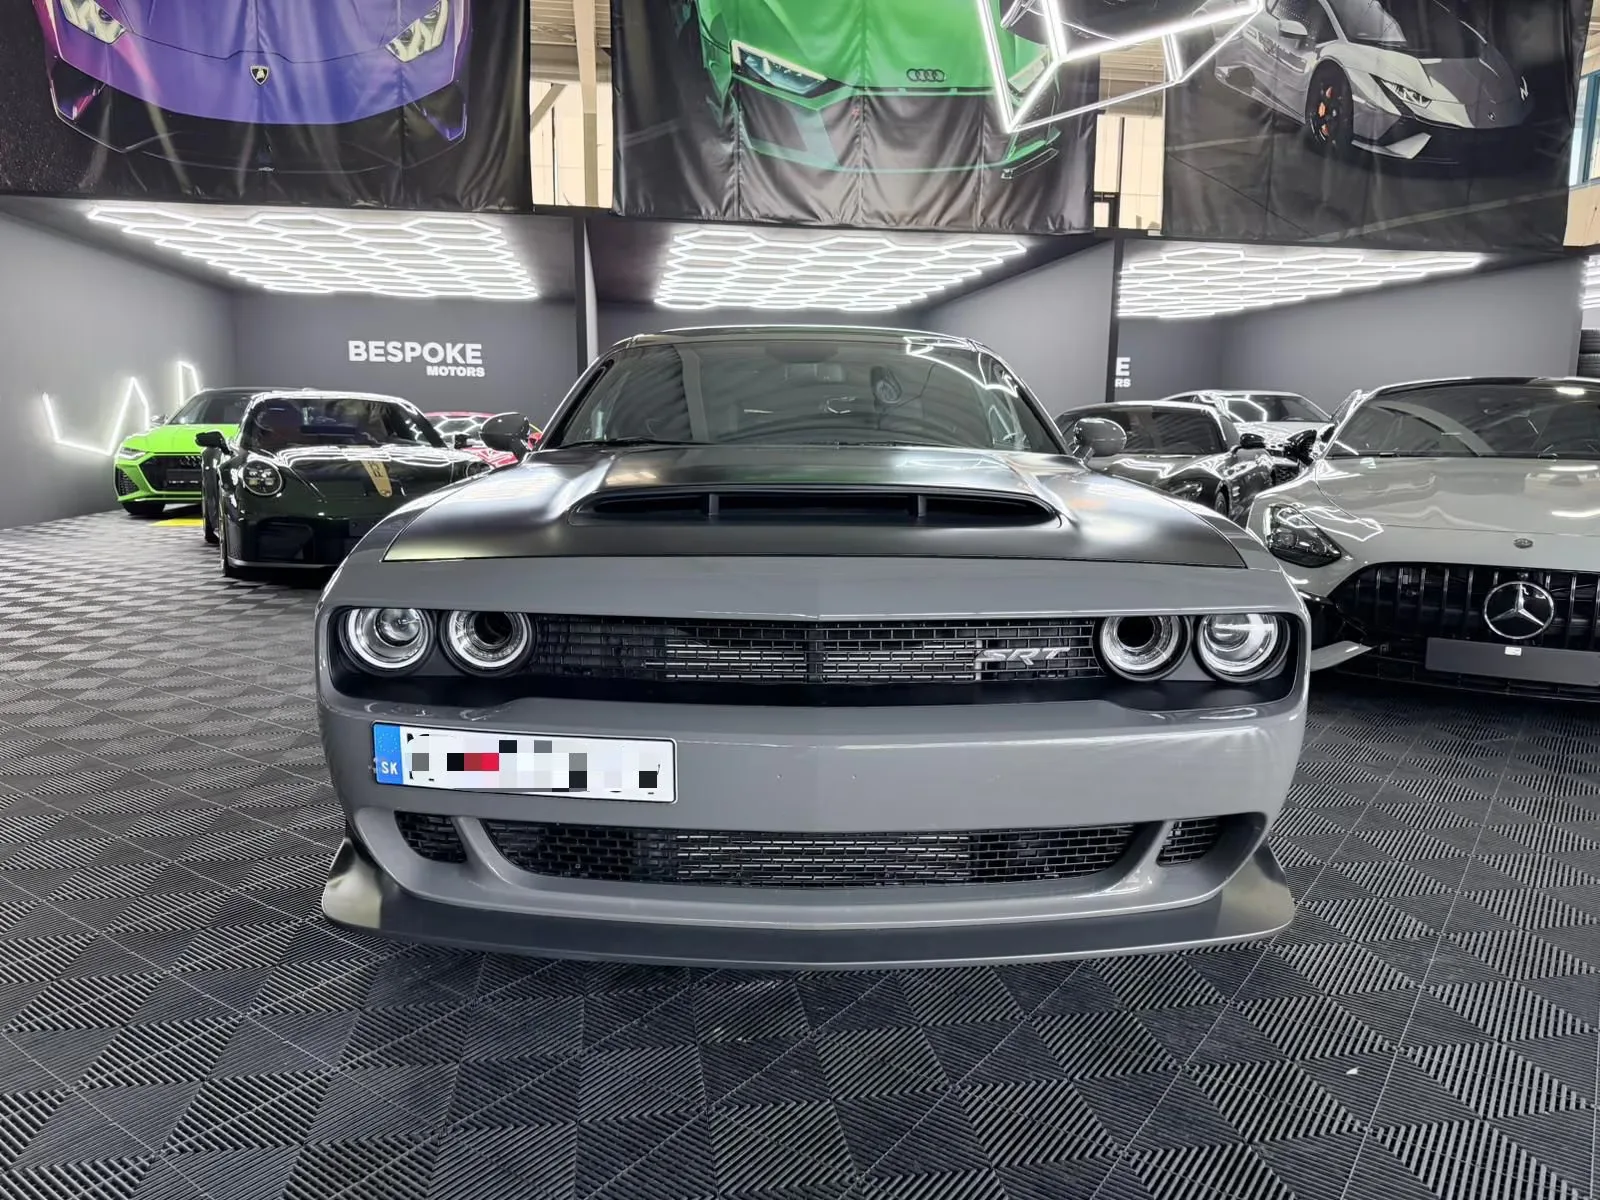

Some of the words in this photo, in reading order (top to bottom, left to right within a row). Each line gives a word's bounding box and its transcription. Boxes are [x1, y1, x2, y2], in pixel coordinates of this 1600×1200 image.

[348, 340, 483, 364] BESPOKE
[426, 365, 485, 377] MOTORS
[975, 647, 1071, 665] SRT
[381, 760, 398, 775] SK
